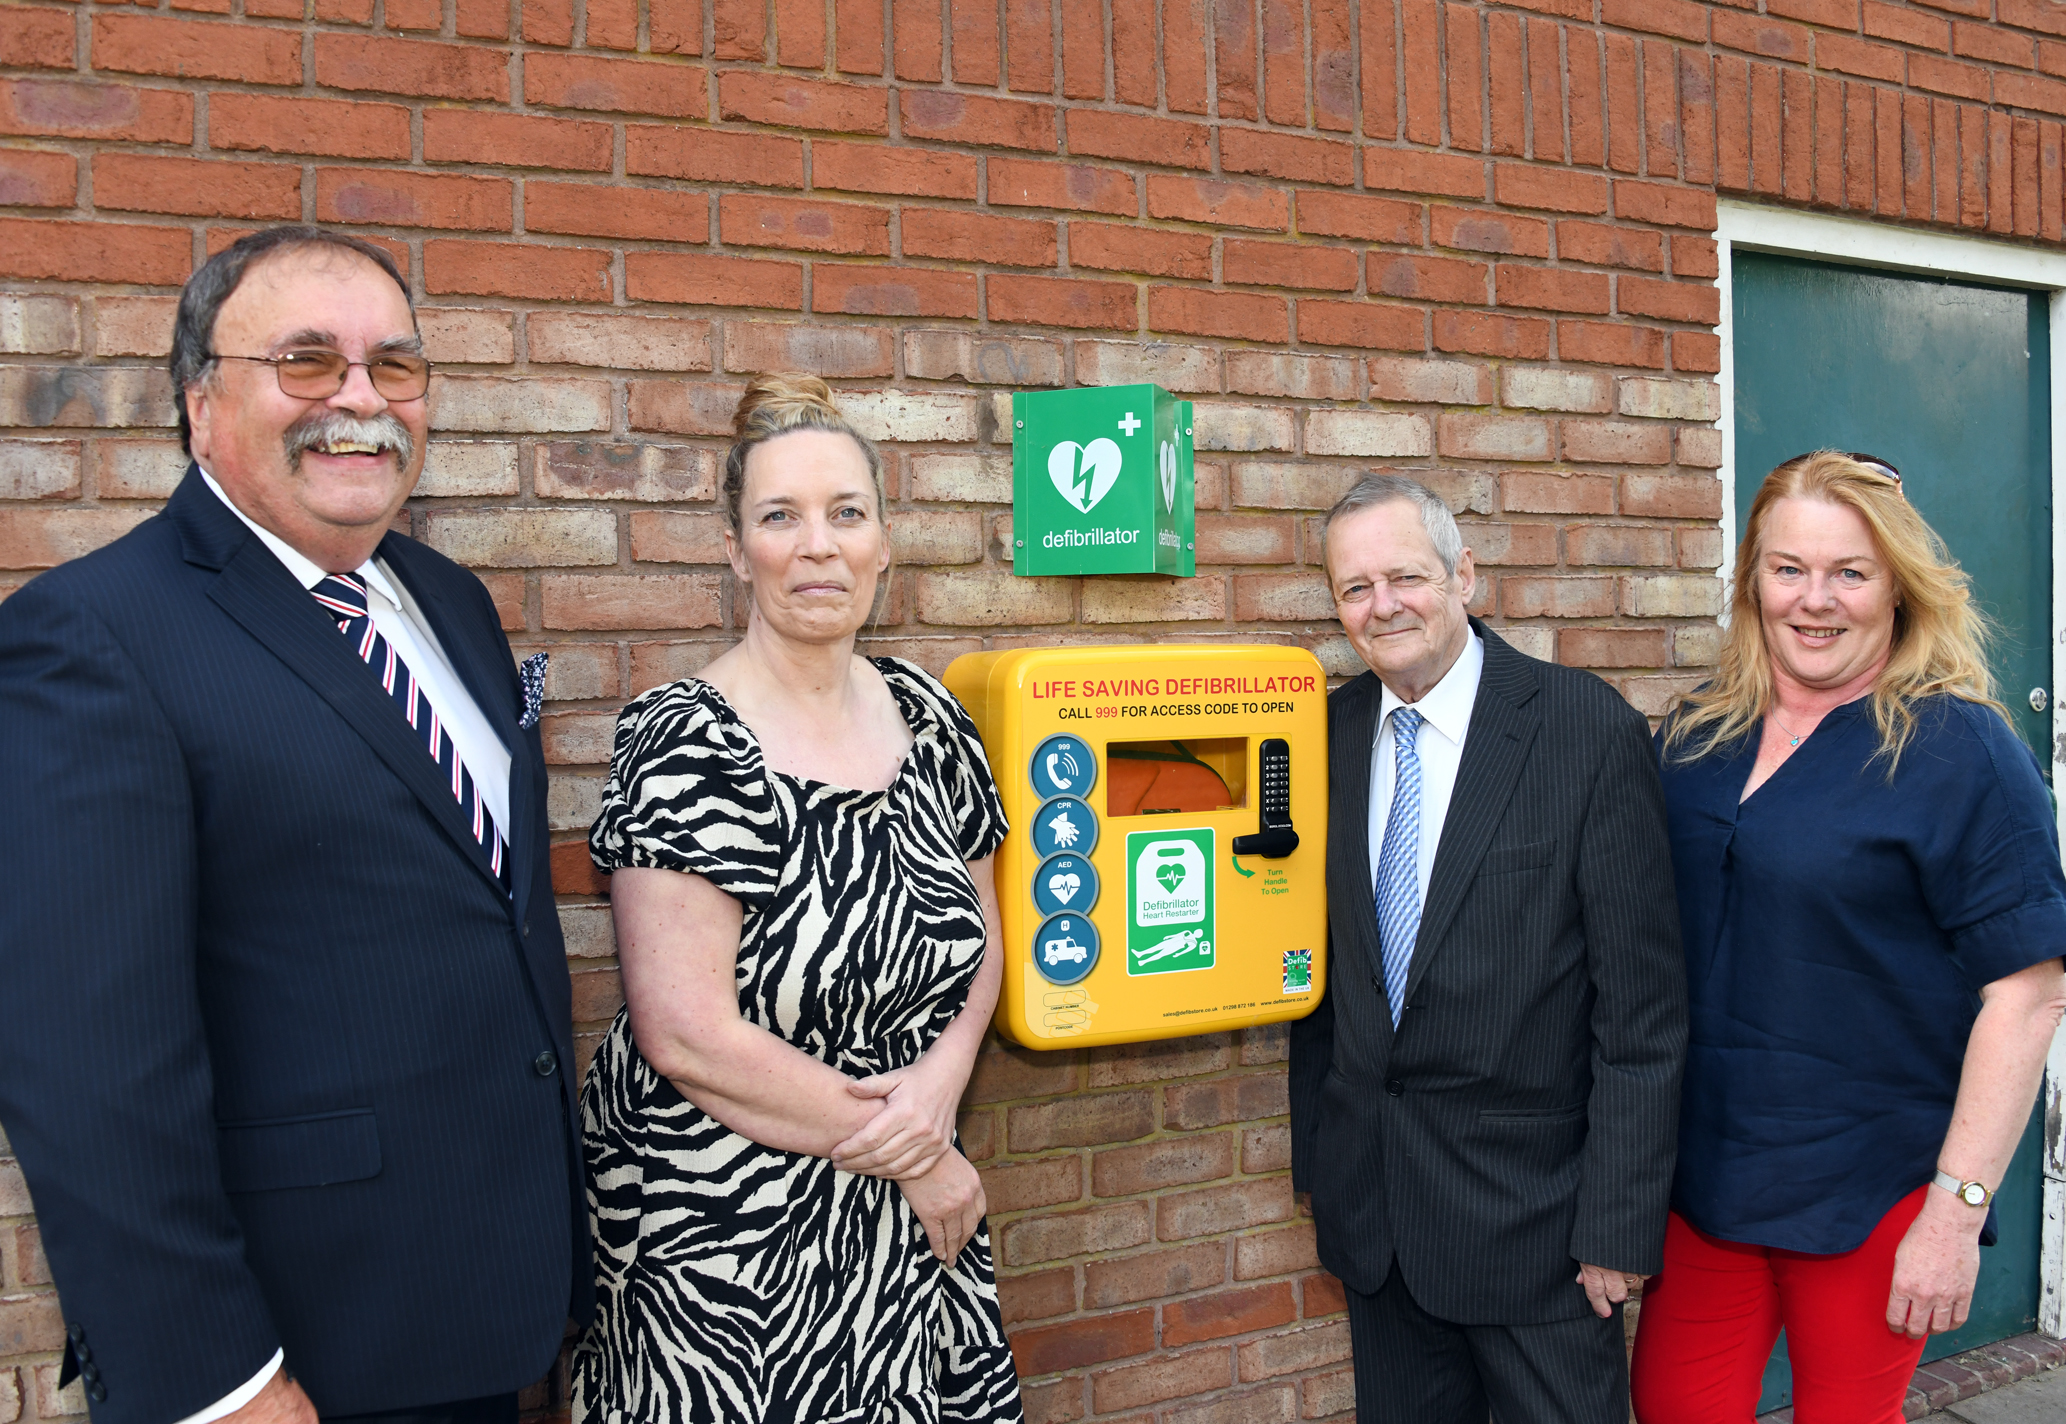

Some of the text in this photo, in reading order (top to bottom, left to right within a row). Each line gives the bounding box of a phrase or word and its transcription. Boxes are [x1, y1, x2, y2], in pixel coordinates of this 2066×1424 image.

[1042, 528, 1140, 548] defibrillator
[1033, 676, 1316, 698] LIFE SAVING DEFIBRILLATOR
[1058, 702, 1294, 720] CALL 999 FOR ACCESS CODE TO OPEN
[1143, 899, 1199, 911] Defibrillator
[1166, 909, 1199, 918] Restarter
[1288, 956, 1307, 965] Defib
[1163, 1006, 1217, 1017] sales@defibstore.co.uk
[1260, 996, 1309, 1006] www.defibstore.co.uk
